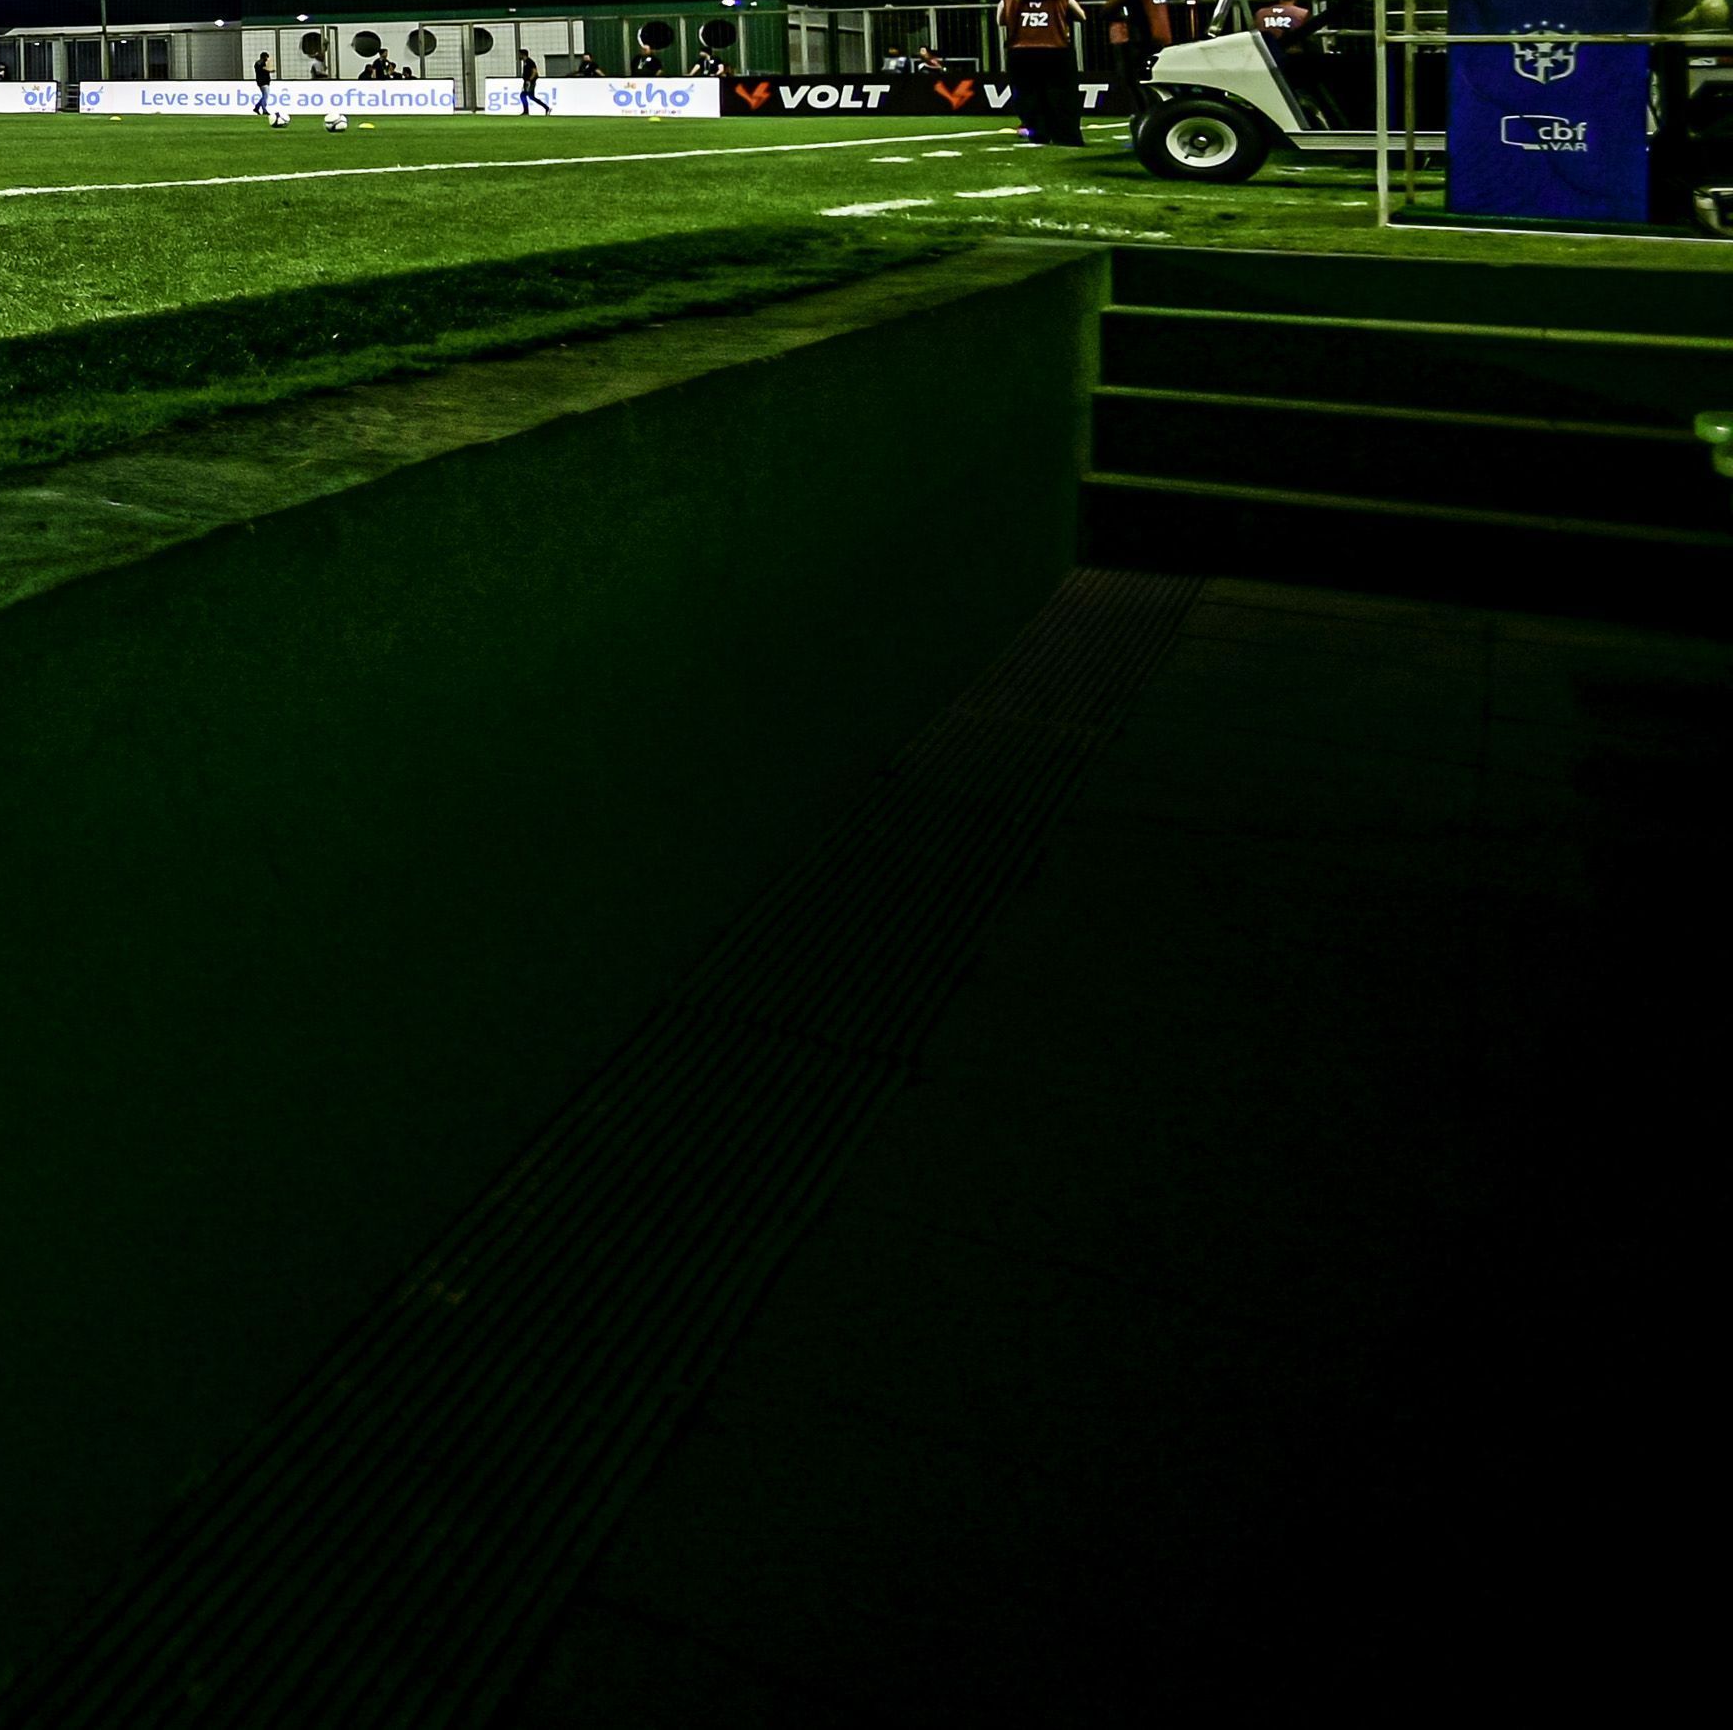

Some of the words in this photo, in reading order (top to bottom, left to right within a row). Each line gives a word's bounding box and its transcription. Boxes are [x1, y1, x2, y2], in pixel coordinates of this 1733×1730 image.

[1021, 12, 1049, 27] 752
[141, 89, 189, 106] Leve
[193, 92, 230, 106] seu
[297, 92, 324, 107] ao
[779, 84, 891, 109] VOLT
[983, 84, 1110, 109] VT
[1538, 122, 1588, 141] cbf
[1549, 142, 1588, 152] VAR
